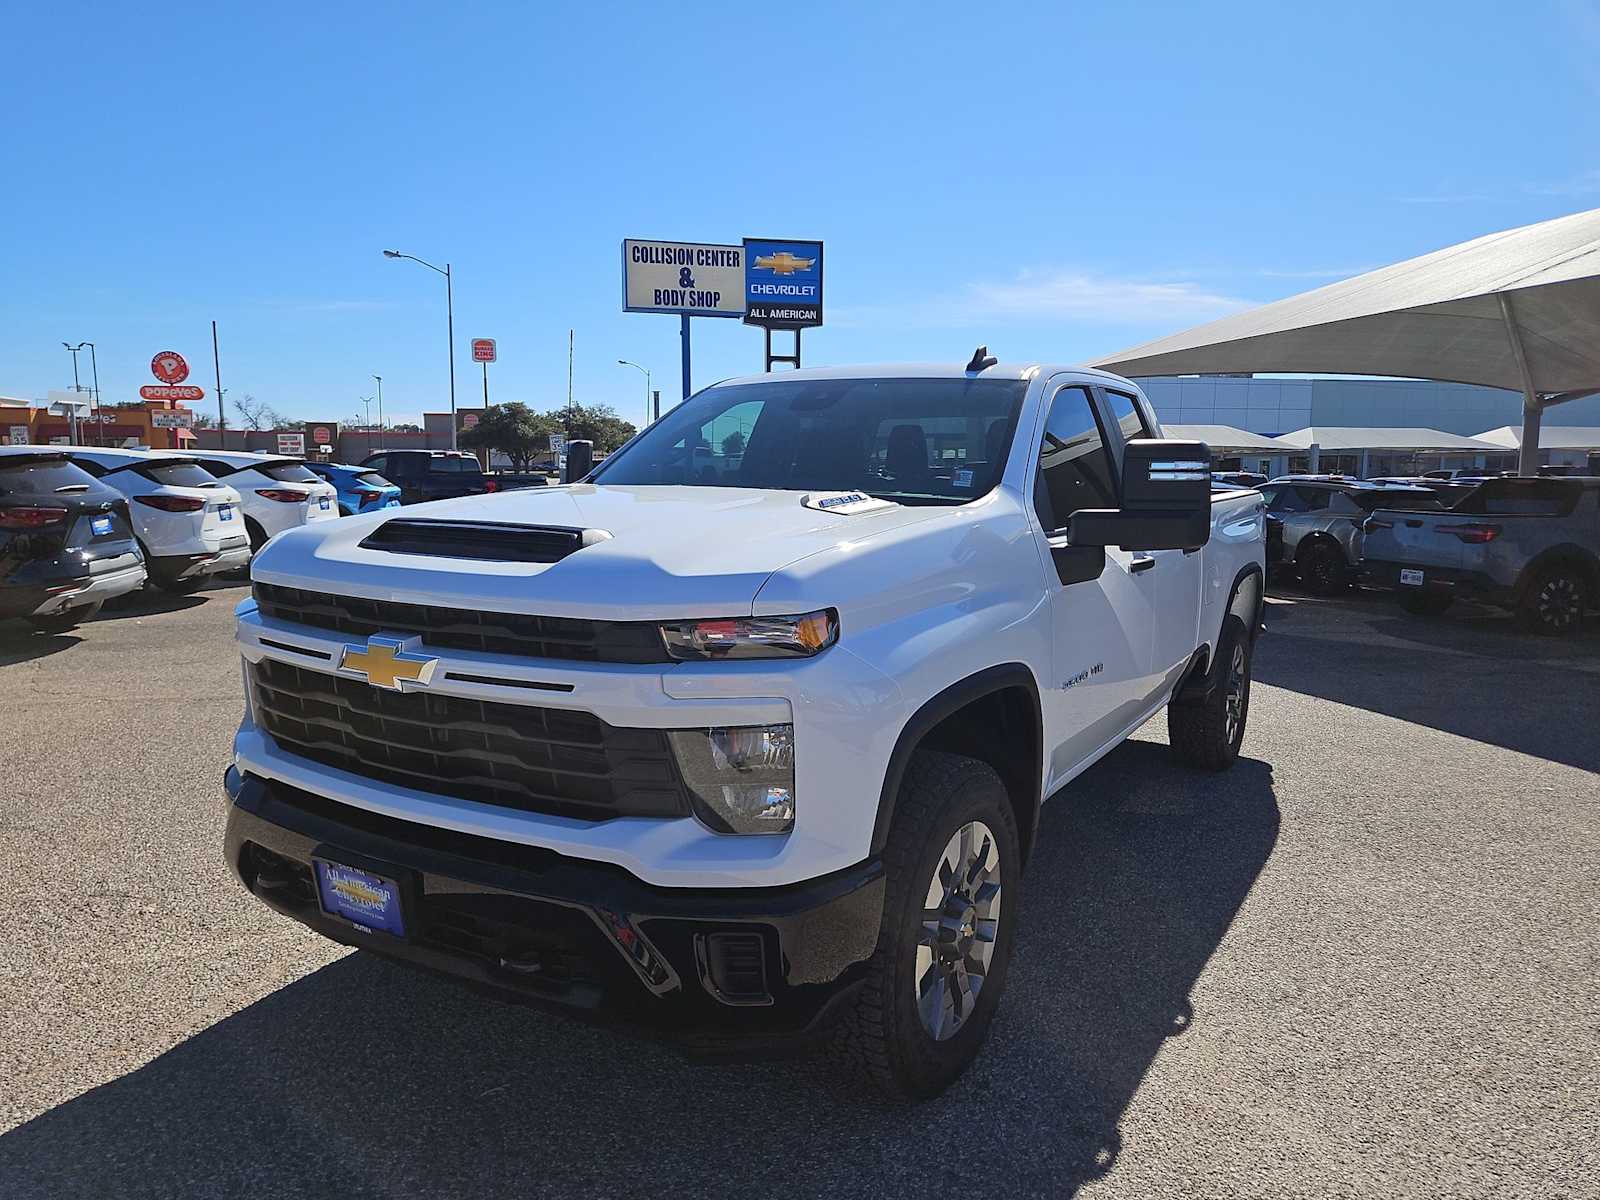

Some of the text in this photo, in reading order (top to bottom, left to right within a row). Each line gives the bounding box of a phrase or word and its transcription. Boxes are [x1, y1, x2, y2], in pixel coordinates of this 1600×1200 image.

[632, 246, 740, 267] COLLISION CENTER
[679, 267, 696, 288] &
[654, 289, 721, 308] BODY SHOP
[750, 284, 816, 296] CHEVROLET
[750, 308, 817, 320] ALL AMERICAN
[326, 870, 339, 881] All
[343, 874, 391, 900] American
[336, 888, 385, 912] Chevrolet
